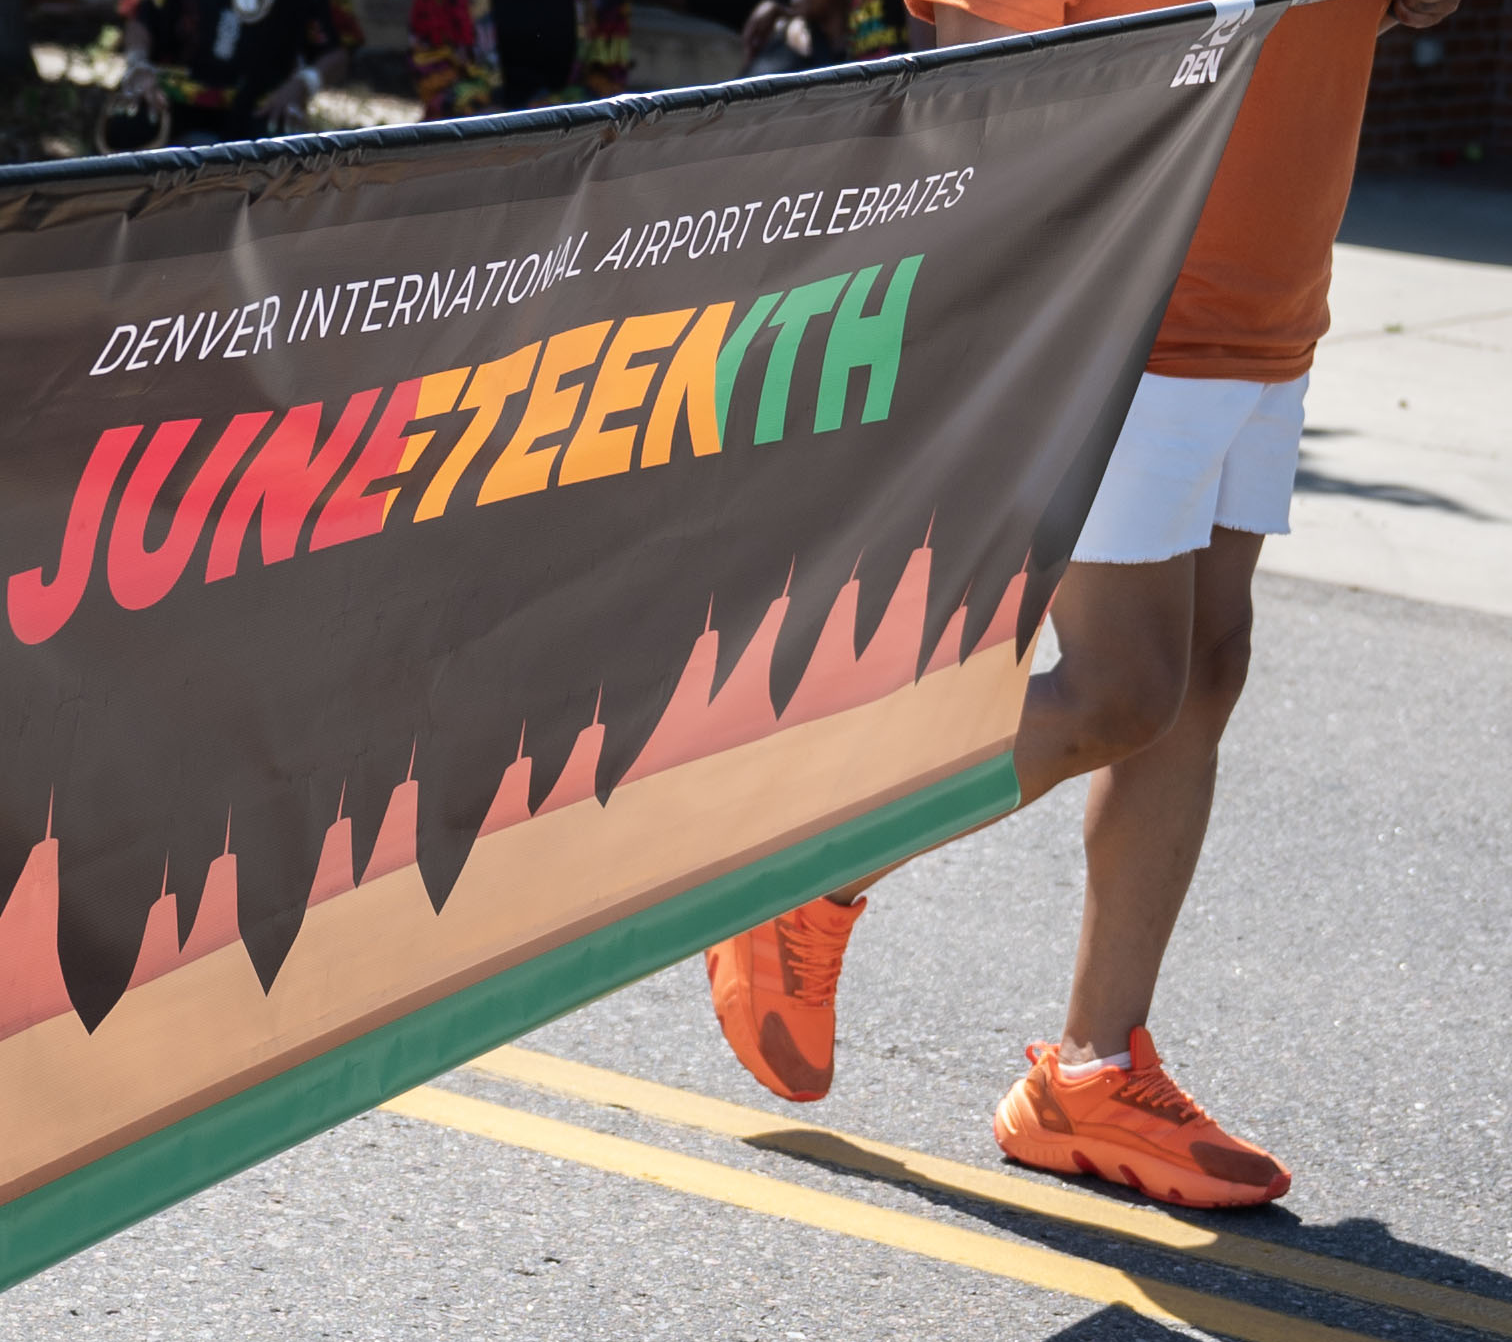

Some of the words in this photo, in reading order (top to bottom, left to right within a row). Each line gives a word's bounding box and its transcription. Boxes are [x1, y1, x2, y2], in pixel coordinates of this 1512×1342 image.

[1170, 47, 1225, 89] DEN
[88, 295, 282, 377] DENVER
[286, 230, 590, 345] INTERNATIONAL
[592, 195, 764, 273] AIRPORT
[761, 165, 976, 245] CELEBRATES
[7, 254, 923, 647] JUNETEENTH
